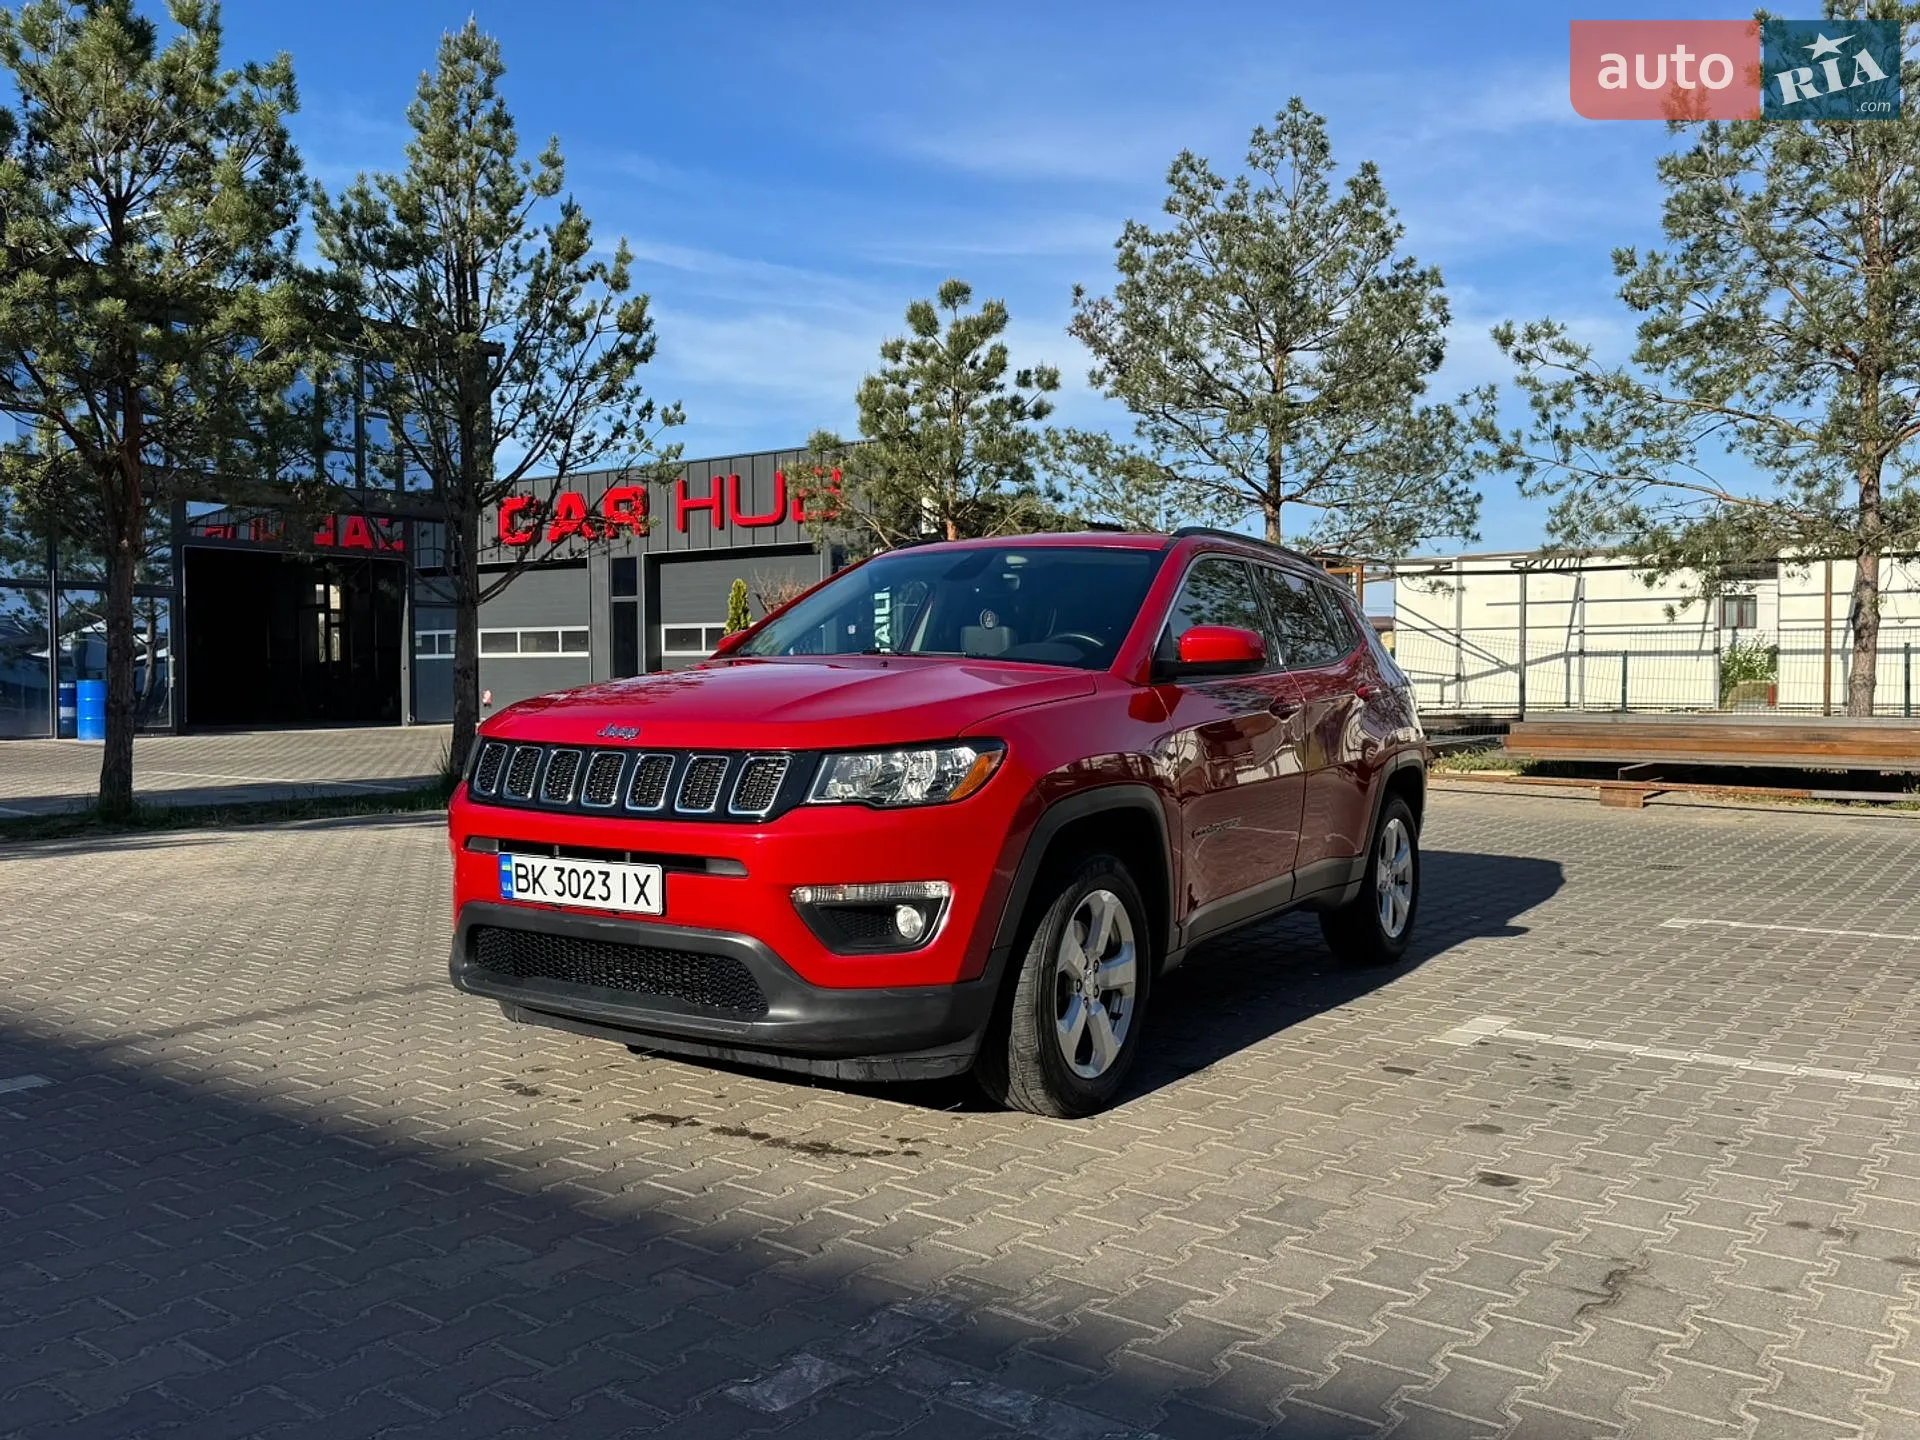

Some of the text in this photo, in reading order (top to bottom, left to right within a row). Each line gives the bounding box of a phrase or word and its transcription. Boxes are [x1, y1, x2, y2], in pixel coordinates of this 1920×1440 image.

[498, 485, 650, 546] CAR
[501, 881, 513, 892] UA
[514, 862, 652, 906] BK 3023 IX
